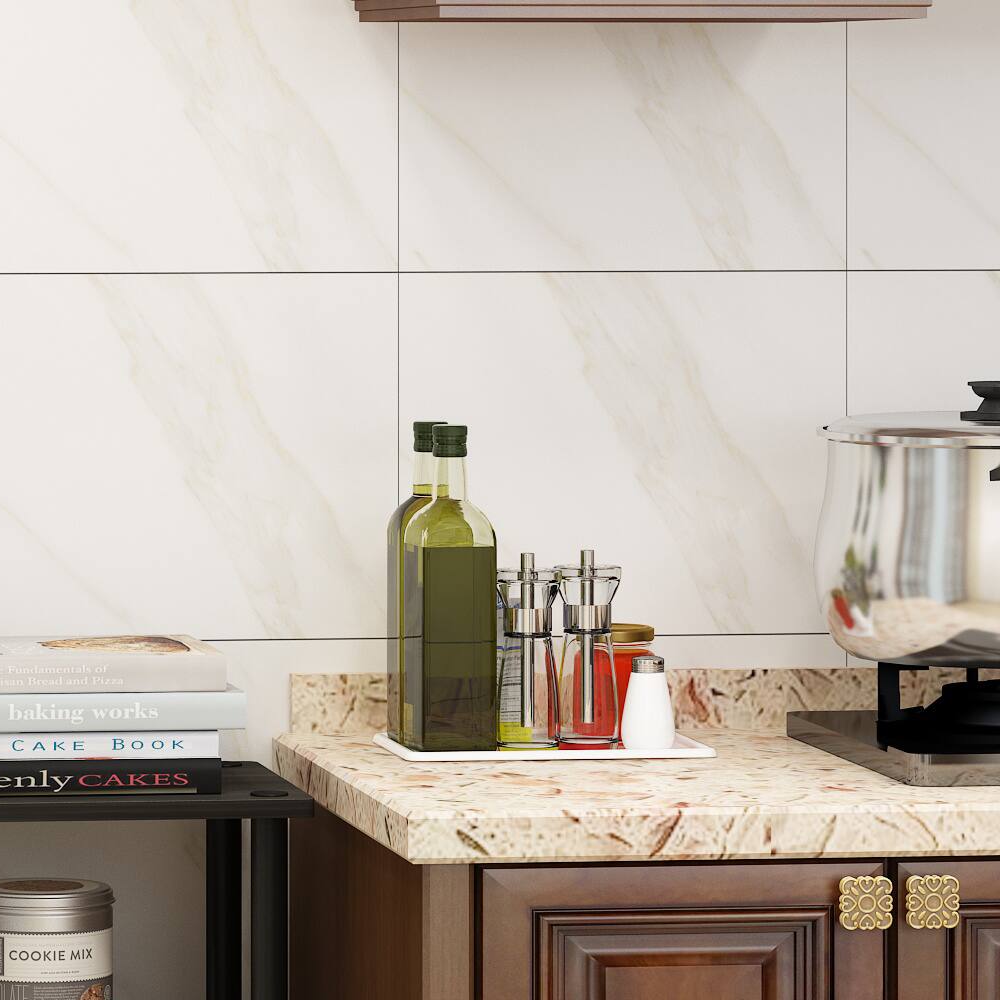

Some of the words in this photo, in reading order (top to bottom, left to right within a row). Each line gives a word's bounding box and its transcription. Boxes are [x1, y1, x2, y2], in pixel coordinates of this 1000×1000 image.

[7, 664, 91, 675] Fundamentals
[94, 663, 108, 674] of
[27, 676, 63, 687] Bread
[65, 676, 88, 686] and
[92, 676, 124, 686] Pizza
[7, 703, 84, 725] baking
[92, 702, 159, 720] works
[12, 739, 85, 752] CAKE
[112, 738, 185, 751] BOOK
[78, 773, 189, 787] CAKES
[9, 950, 66, 962] COOKIE
[70, 948, 93, 960] MIX
